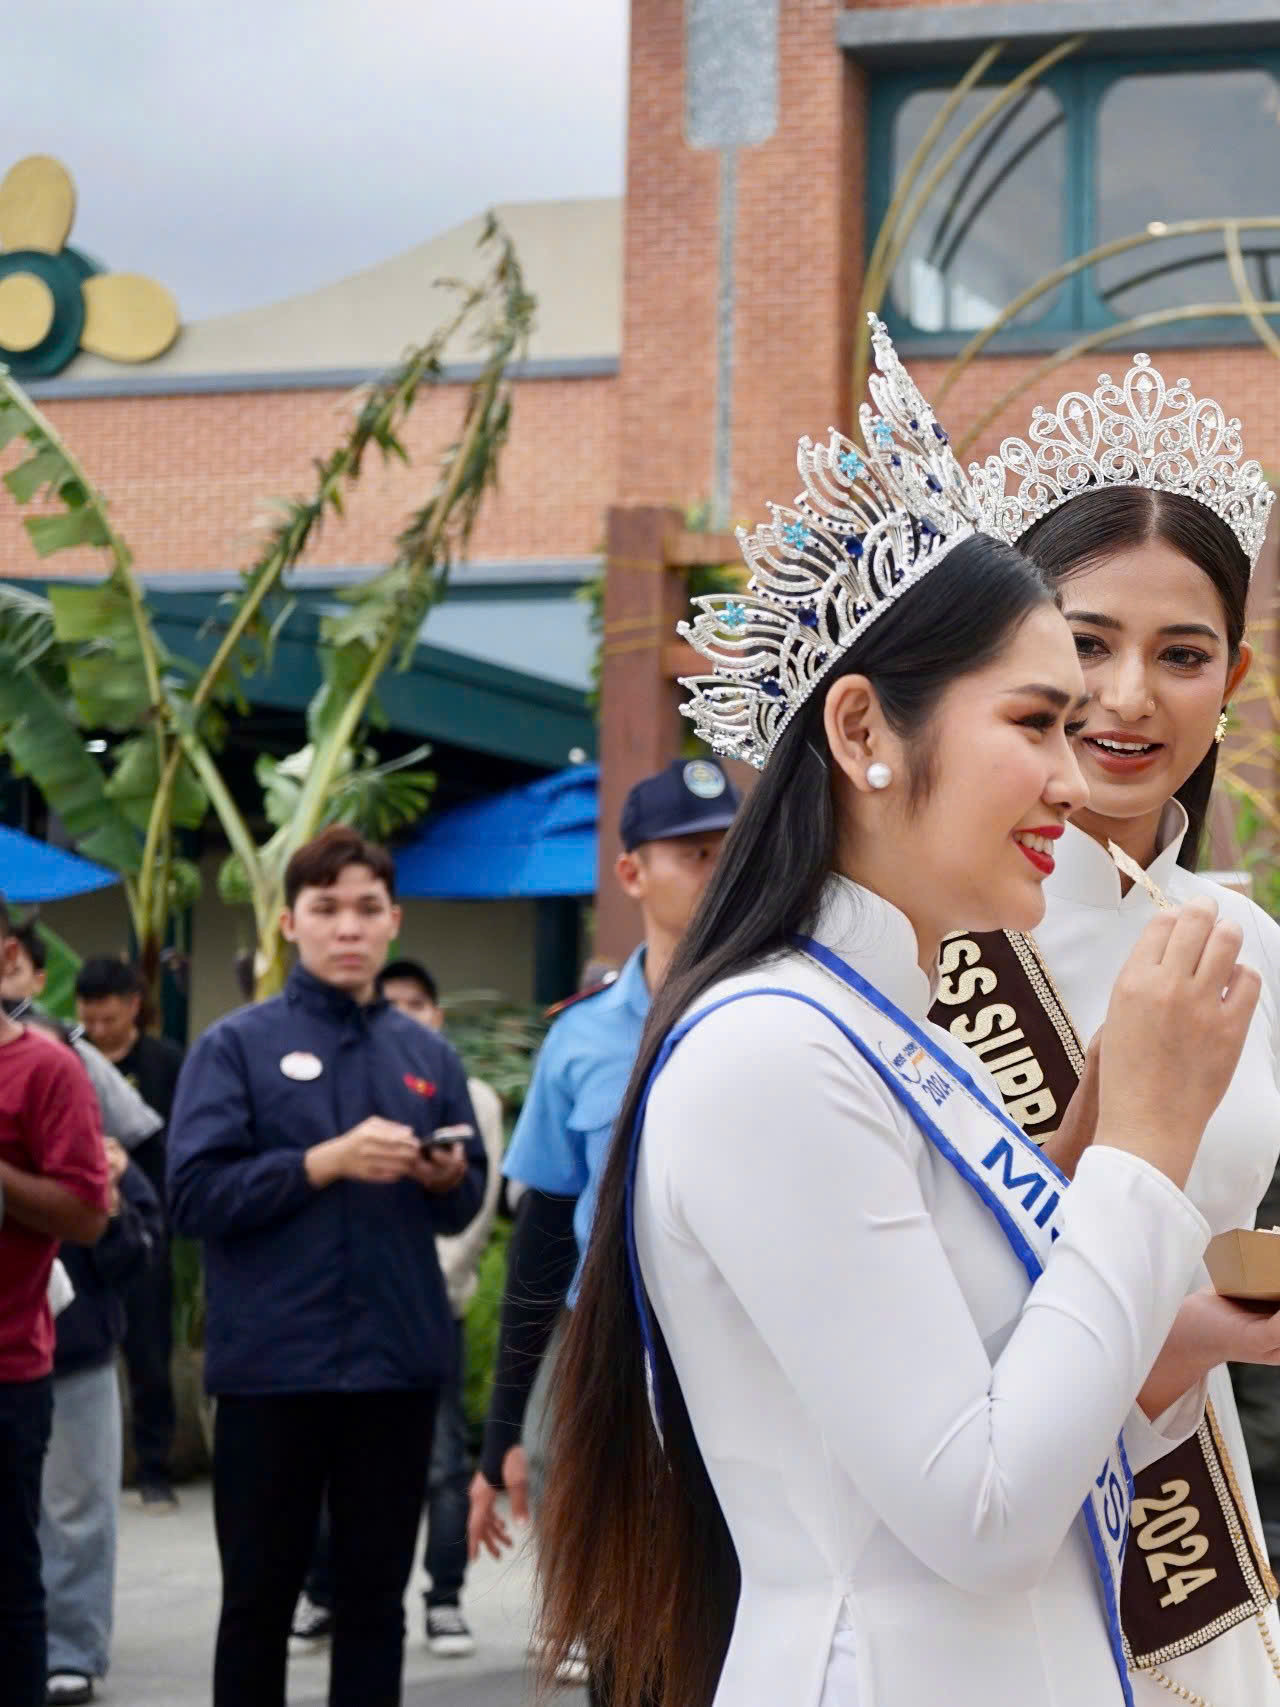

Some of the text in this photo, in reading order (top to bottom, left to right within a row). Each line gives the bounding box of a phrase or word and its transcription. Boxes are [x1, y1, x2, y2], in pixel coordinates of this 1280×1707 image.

[921, 1077, 954, 1107] 2024
[937, 930, 1058, 1146] SS SUPR
[981, 1137, 1061, 1243] MI
[1130, 1479, 1218, 1608] 2024
